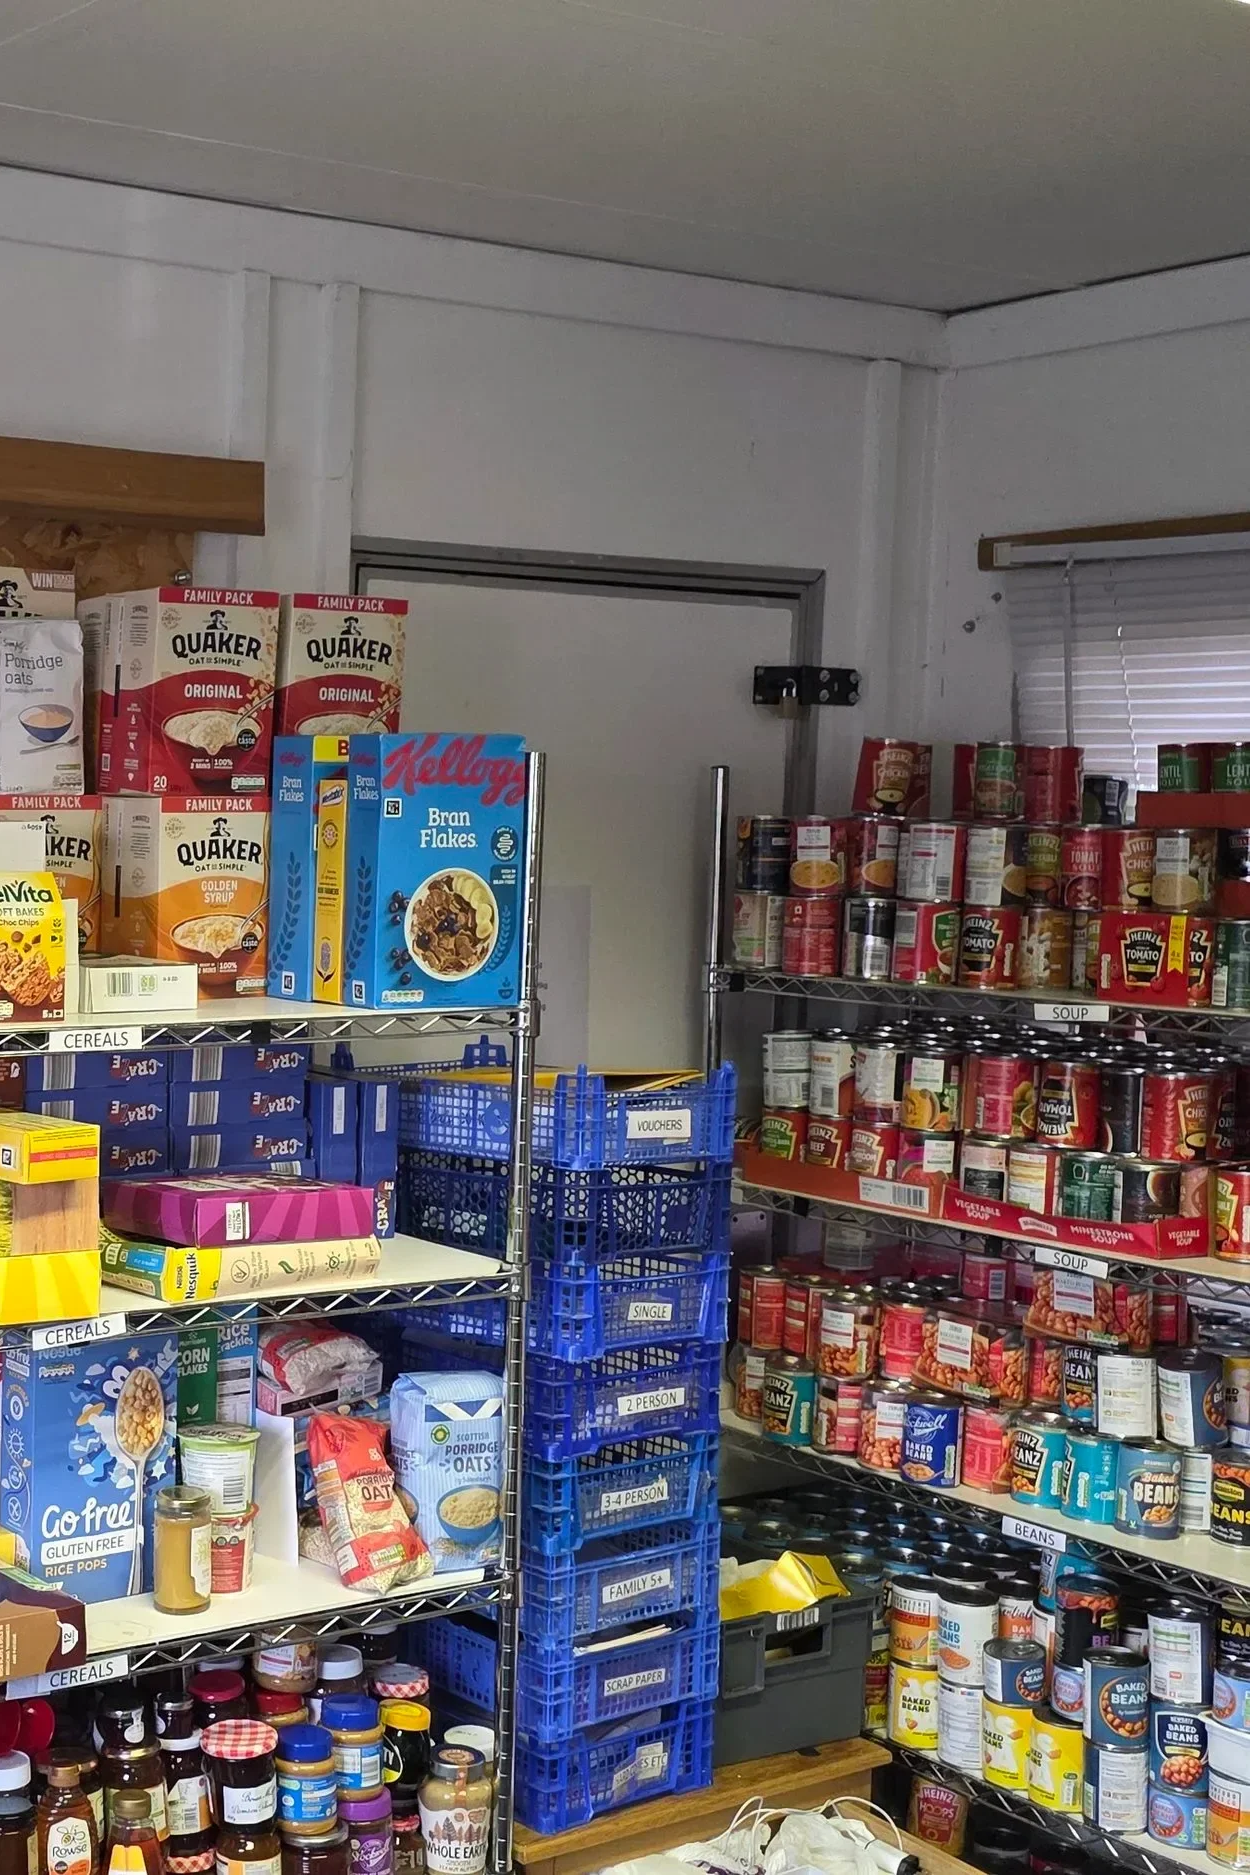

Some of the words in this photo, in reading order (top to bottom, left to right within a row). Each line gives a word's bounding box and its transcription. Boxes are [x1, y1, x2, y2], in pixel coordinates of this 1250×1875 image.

[31, 573, 53, 588] WIN
[184, 589, 219, 604] FAMILY
[221, 591, 254, 605] PACK
[317, 596, 353, 609] FAMILY
[355, 599, 385, 612] PACK
[172, 631, 263, 661] QUAKER
[306, 637, 393, 665] QUAKER
[4, 653, 64, 671] Porridge
[4, 671, 34, 686] oats
[184, 683, 243, 699] ORIGINAL
[318, 687, 375, 703] ORIGINAL
[153, 775, 167, 790] 20
[281, 775, 303, 789] Bran
[279, 788, 304, 802] Flakes
[427, 807, 471, 827] Bran
[419, 828, 478, 849] Flakes
[176, 841, 263, 867] QUAKER
[200, 878, 238, 892] GOLDEN
[203, 890, 235, 904] SYRUP
[15, 906, 45, 918] BAKES
[17, 919, 40, 928] Chips
[1129, 930, 1159, 943] HEINZ
[1125, 948, 1159, 961] TOMATO
[1052, 1006, 1089, 1020] SOUP
[63, 1031, 129, 1050] CEREALS
[636, 1117, 683, 1133] VOUCHERS
[376, 1180, 395, 1238] CRAZE
[954, 1198, 1001, 1218] VEGETABLE
[966, 1209, 991, 1222] SOUP
[1069, 1224, 1135, 1242] MINESTRONE
[1090, 1234, 1118, 1246] SOUP
[1168, 1229, 1201, 1240] VEGETABLE
[1053, 1252, 1089, 1271] SOUP
[185, 1252, 198, 1300] Nesquik
[632, 1305, 668, 1320] SINGLE
[45, 1320, 111, 1346] CEREALS
[177, 1346, 210, 1365] CORN
[177, 1362, 210, 1377] FLAKES
[626, 1398, 633, 1412] 2
[635, 1390, 678, 1410] PERSON
[456, 1432, 490, 1442] SCOTTISH
[445, 1442, 499, 1456] PORRIDGE
[906, 1439, 934, 1455] BAKED
[906, 1450, 934, 1462] BEANS
[453, 1456, 492, 1473] OATS
[1141, 1473, 1177, 1485] Baked
[603, 1493, 623, 1508] 3-4
[624, 1484, 665, 1504] PERSON
[1133, 1482, 1181, 1505] BEANS
[41, 1506, 80, 1539] Go
[82, 1497, 134, 1529] free
[1014, 1522, 1056, 1546] BEANS
[46, 1542, 95, 1560] GLUTEN
[96, 1535, 125, 1550] FREE
[45, 1564, 75, 1578] RICE
[76, 1558, 108, 1572] POPS
[608, 1578, 649, 1598] FAMILY
[649, 1574, 664, 1590] 5+
[63, 1632, 72, 1644] 12
[49, 1661, 114, 1688] CEREALS
[605, 1676, 635, 1693] SCRAP
[635, 1671, 664, 1687] PAPER
[901, 1695, 931, 1707] BAKED
[901, 1702, 930, 1714] BEANS
[1167, 1723, 1197, 1734] BAKED
[1166, 1730, 1200, 1744] BEANS
[923, 1788, 954, 1803] HEINZ
[920, 1801, 956, 1819] HOOPS
[52, 1844, 88, 1858] Rowse
